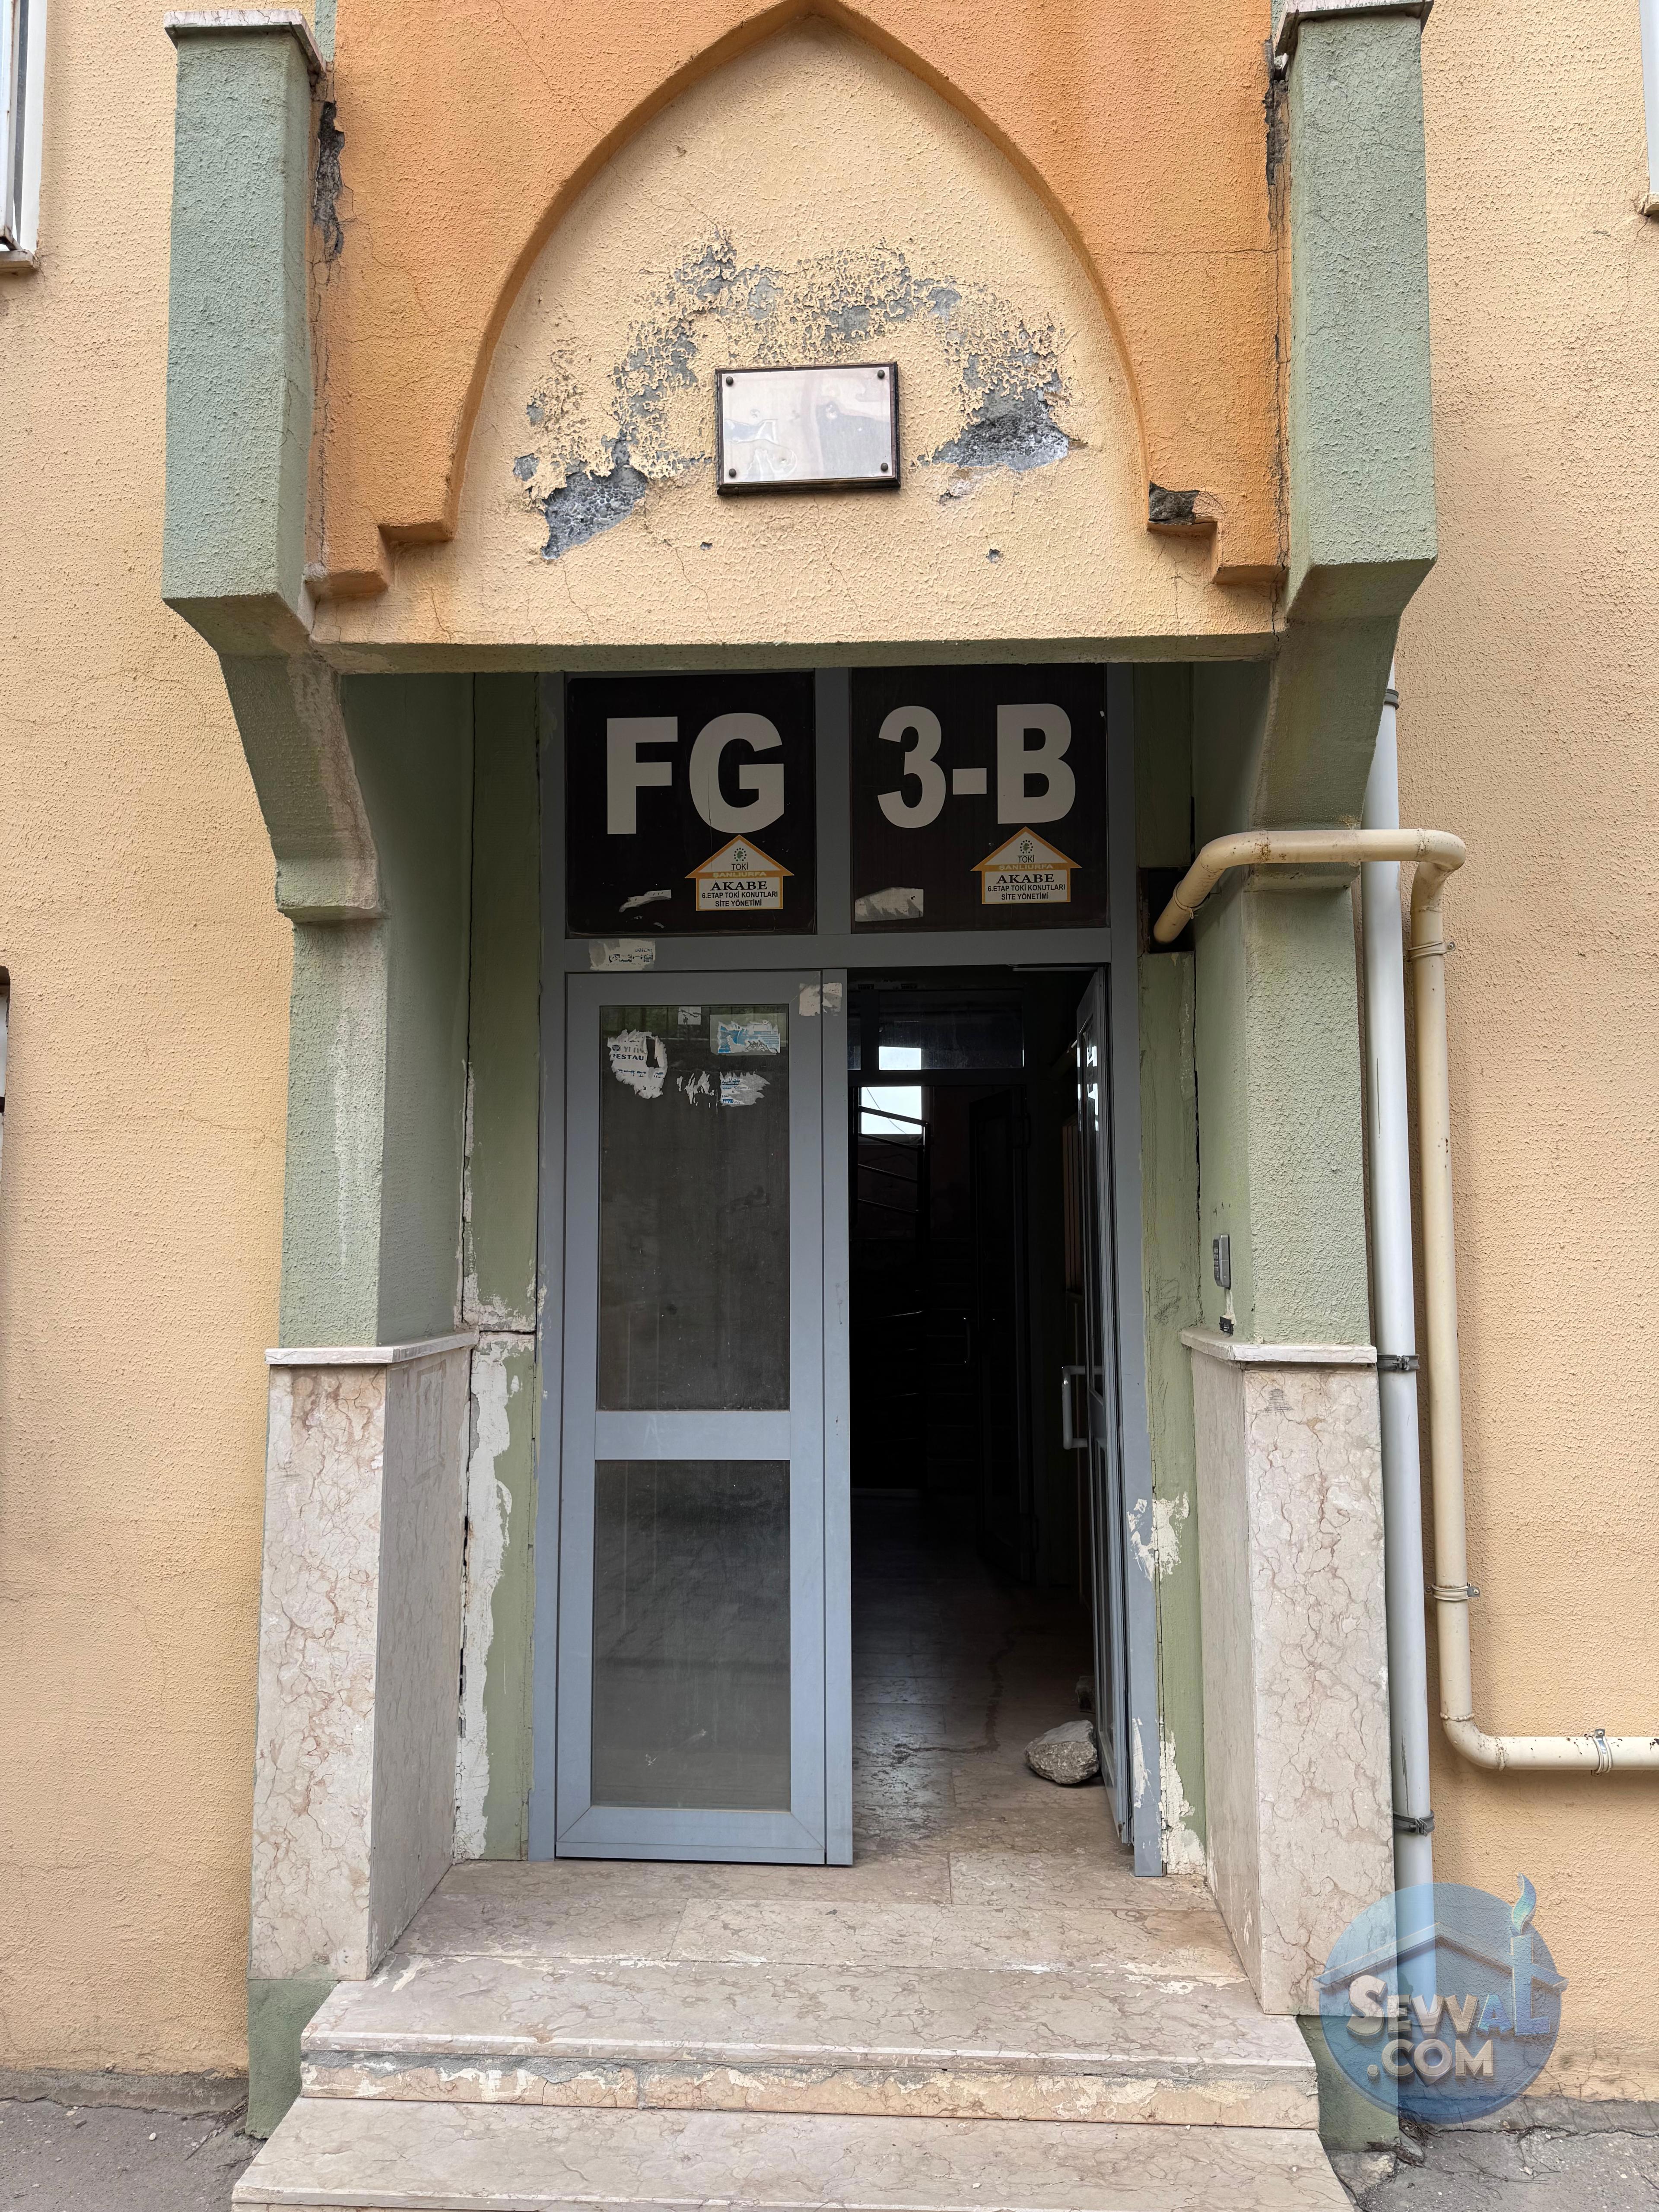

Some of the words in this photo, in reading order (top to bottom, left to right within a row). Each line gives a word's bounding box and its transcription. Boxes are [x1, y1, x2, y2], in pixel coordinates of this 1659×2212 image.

[877, 704, 1076, 828] 3-B
[607, 713, 784, 834] FG
[1017, 855, 1035, 863] TOKİ
[731, 862, 748, 871] TOKİ
[996, 874, 1055, 884] AKABE
[710, 881, 768, 891] AKABE
[1017, 892, 1049, 900] YÖNETİMİ
